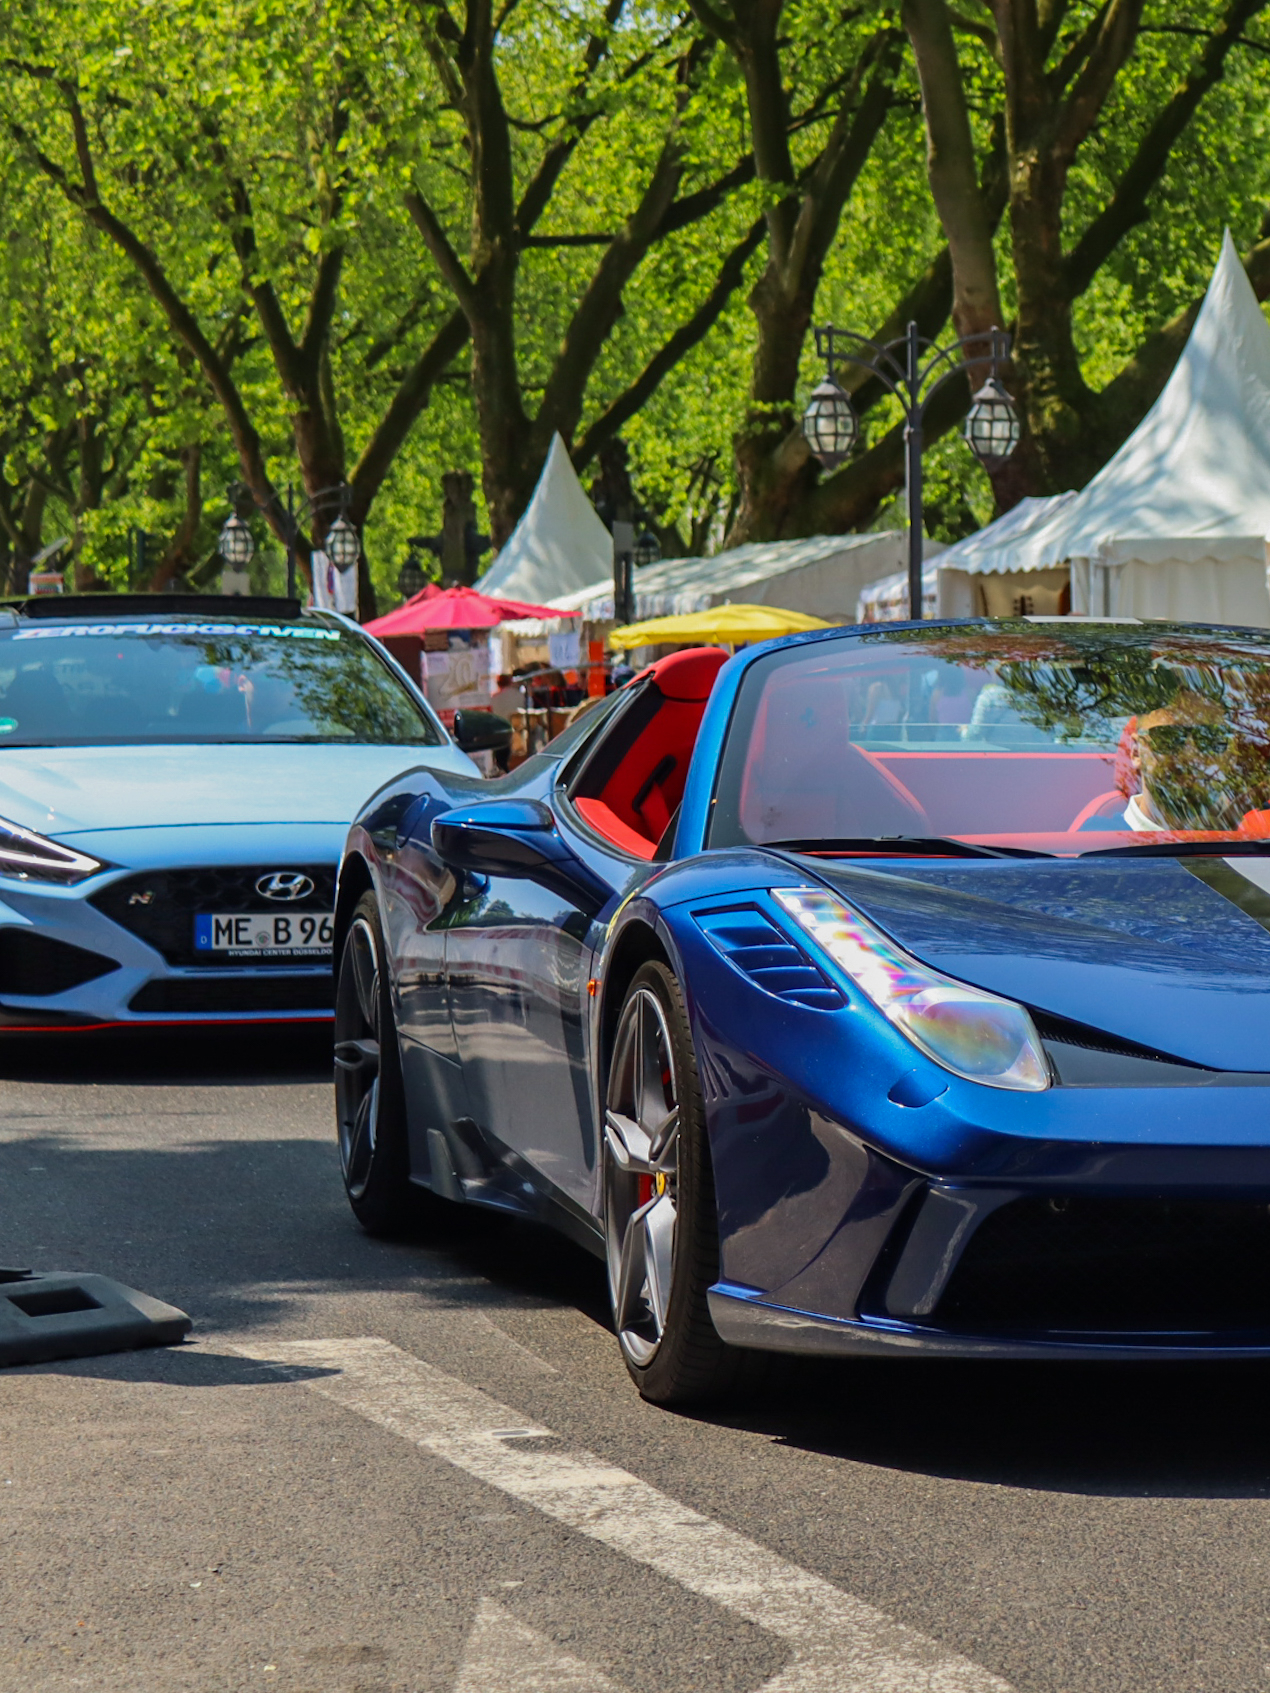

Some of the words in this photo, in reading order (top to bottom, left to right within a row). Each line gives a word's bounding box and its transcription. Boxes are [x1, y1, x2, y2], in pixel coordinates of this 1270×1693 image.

[214, 917, 252, 946] ME
[274, 917, 292, 945] B
[228, 949, 262, 957] HYUNDAI
